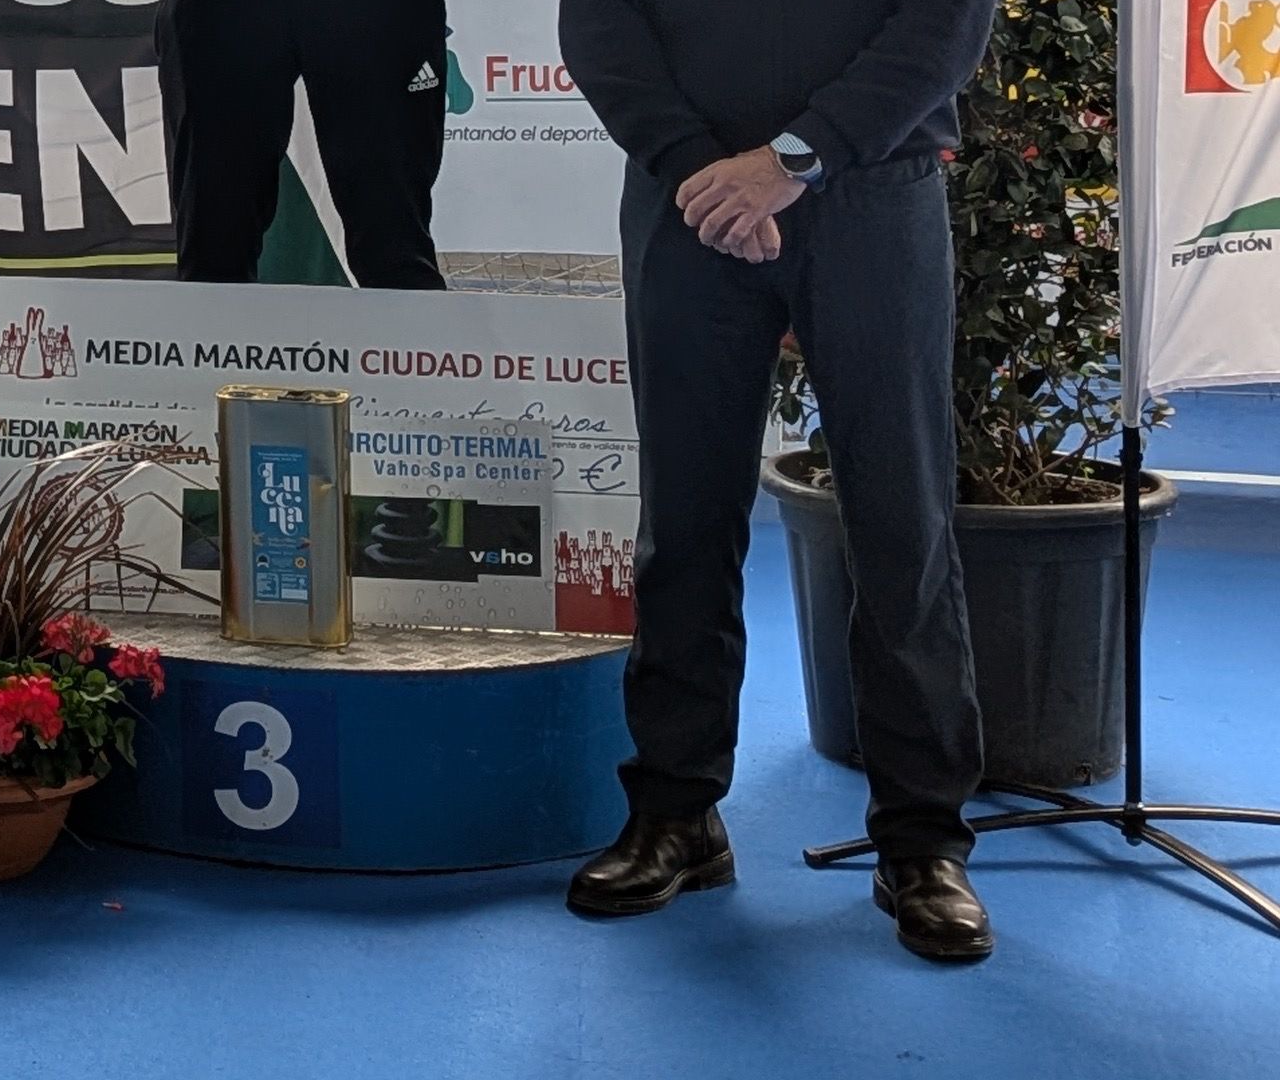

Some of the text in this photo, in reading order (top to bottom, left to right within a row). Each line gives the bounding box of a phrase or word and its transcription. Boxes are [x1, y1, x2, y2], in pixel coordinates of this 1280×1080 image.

[408, 77, 439, 92] adidas
[486, 56, 575, 92] Fruc
[443, 125, 610, 145] entando el deporte
[1171, 232, 1272, 267] FEDERACIÓN
[86, 339, 629, 385] MEDIA MARATÓN CIUDAD DE LUCE
[63, 420, 177, 444] MARATÓN
[349, 432, 547, 459] IRCUITO TERMAL
[374, 460, 421, 477] Vaho
[430, 462, 466, 482] Spa
[476, 463, 541, 481] Center
[214, 701, 300, 831] 3
